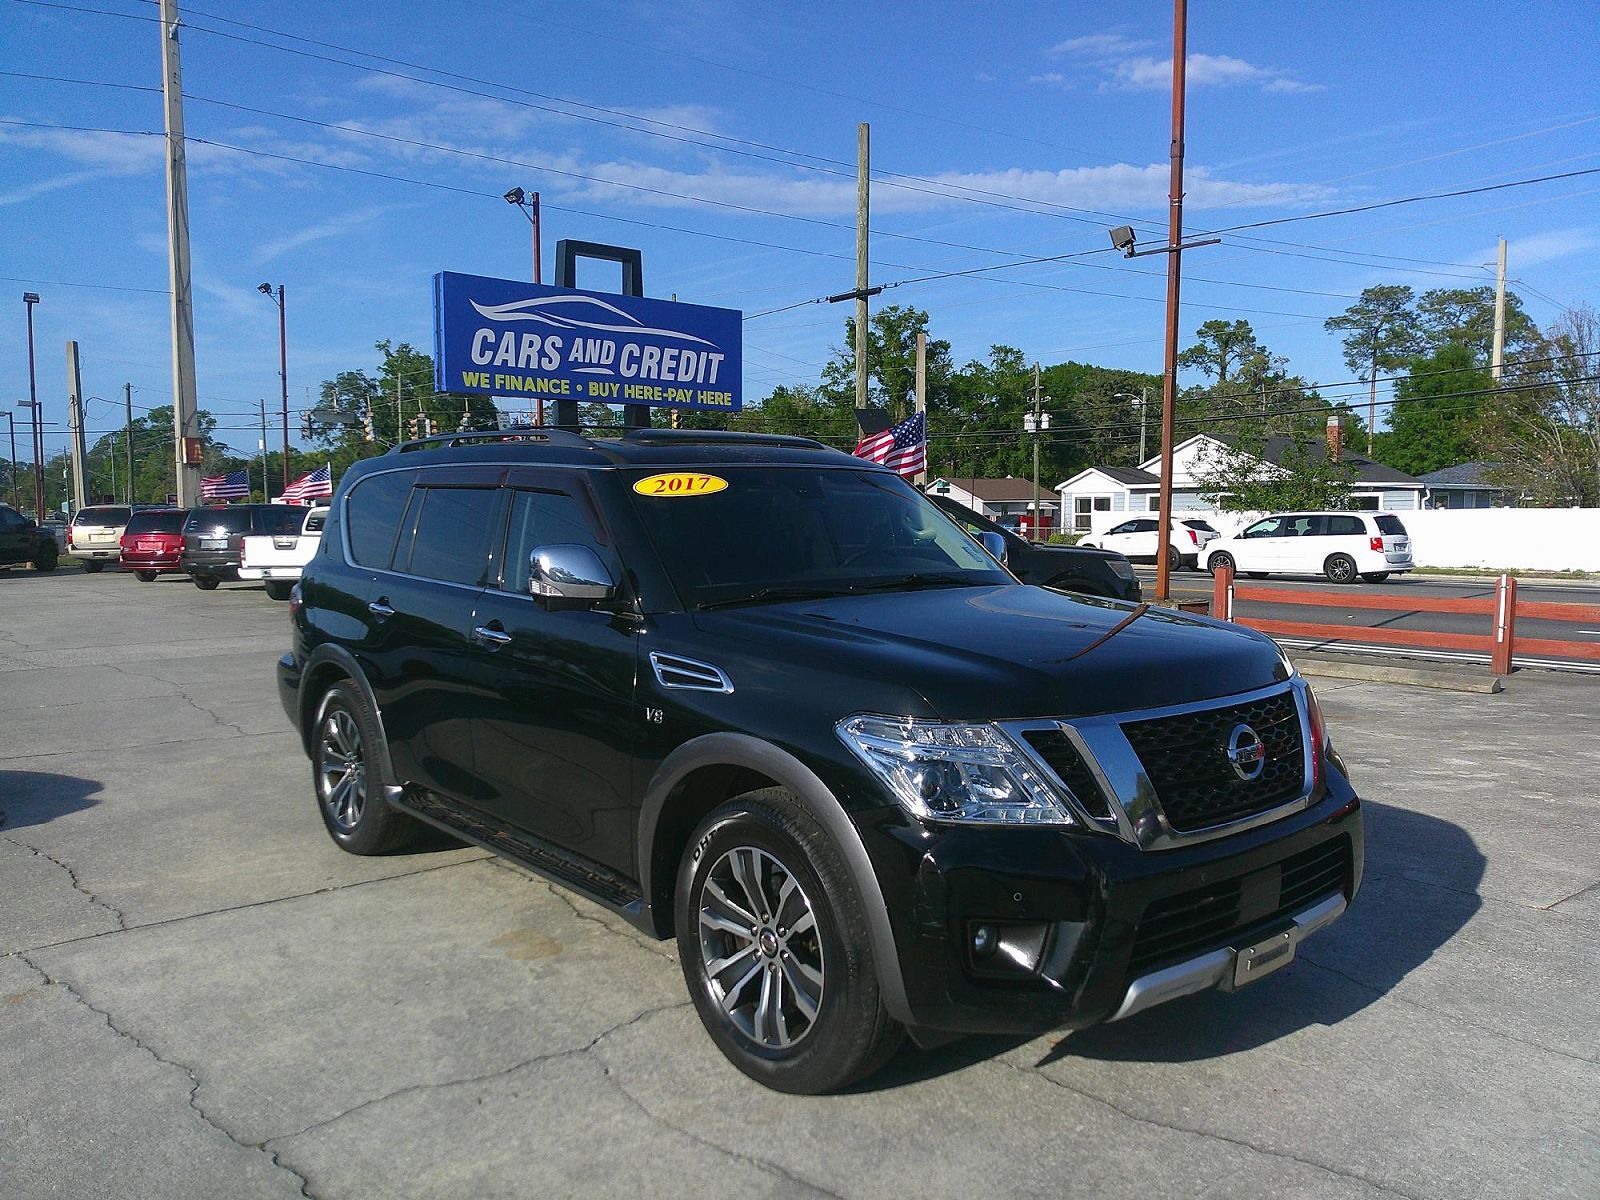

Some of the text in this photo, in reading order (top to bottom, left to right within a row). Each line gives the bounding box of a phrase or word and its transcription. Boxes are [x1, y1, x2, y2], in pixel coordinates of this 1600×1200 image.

[471, 328, 725, 385] CARS AND CREDIT
[462, 371, 732, 407] WE FINANCE BUY HERE-PAY HERE
[653, 477, 711, 493] 2017
[646, 707, 663, 724] V8
